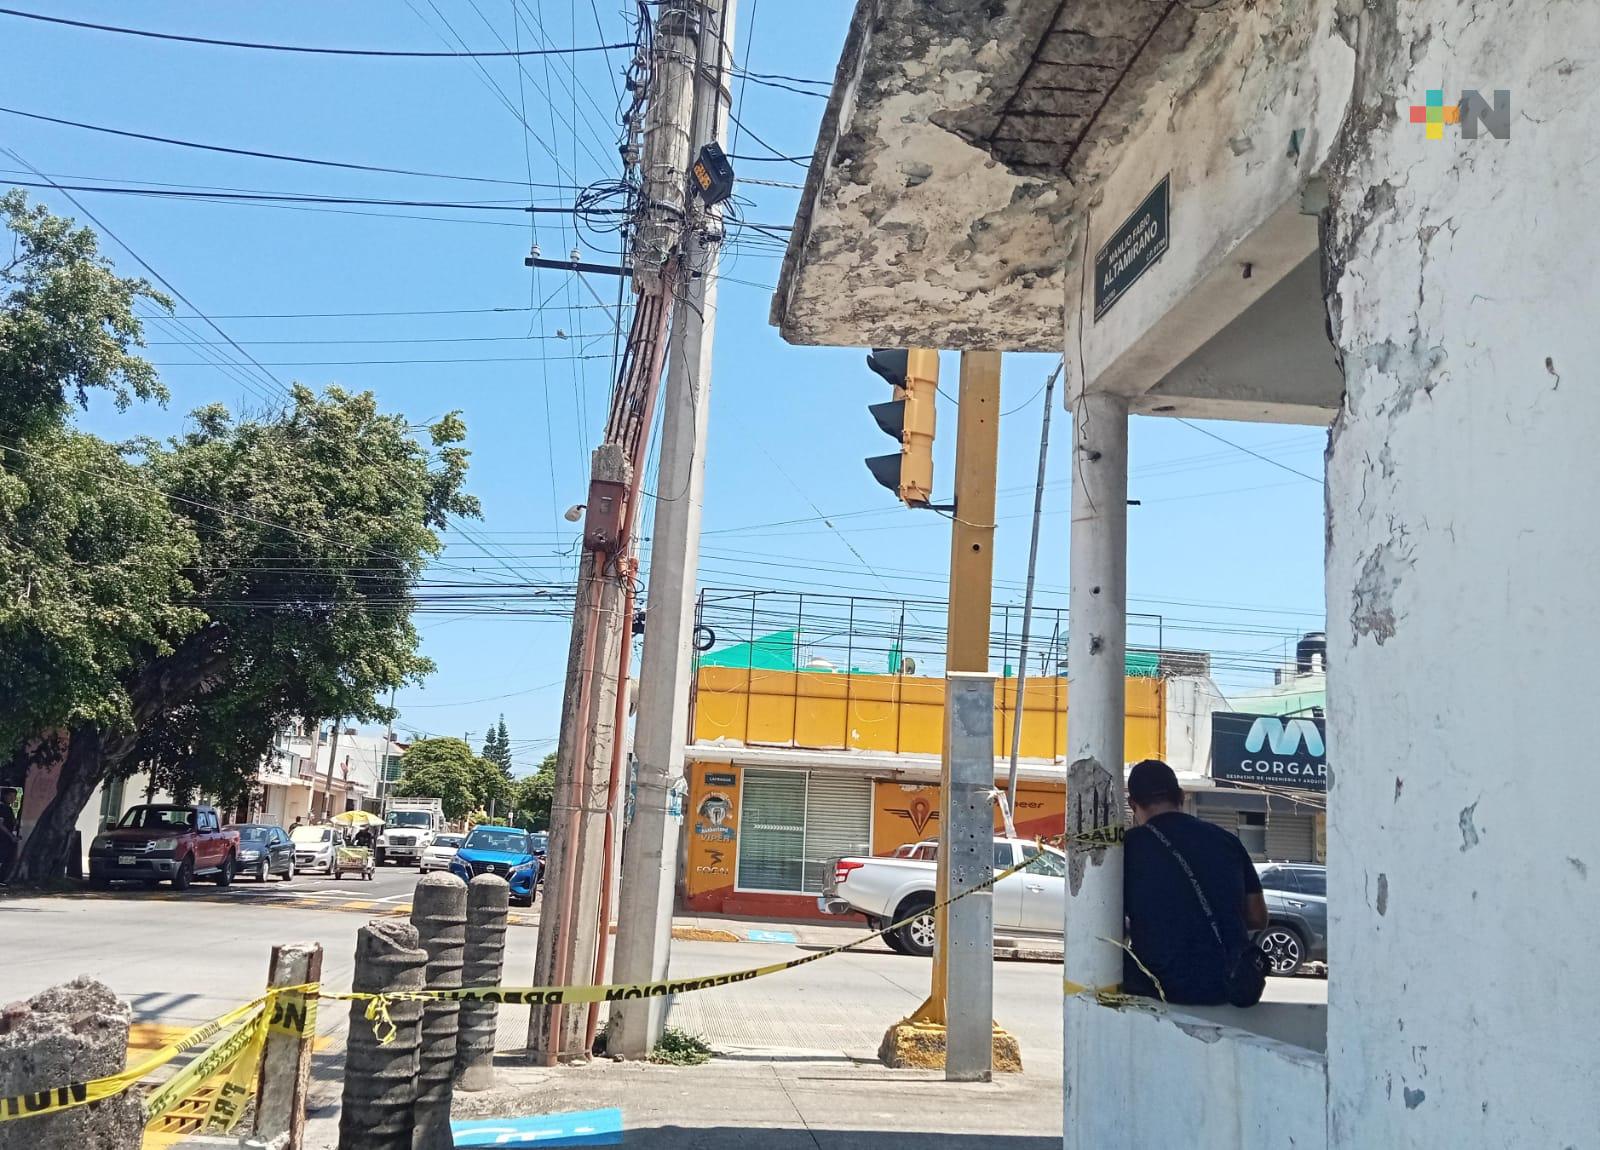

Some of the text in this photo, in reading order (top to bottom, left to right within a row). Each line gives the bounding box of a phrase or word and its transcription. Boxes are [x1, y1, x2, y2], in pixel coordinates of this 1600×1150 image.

[1103, 220, 1158, 291] ALTAMIRANO
[1109, 212, 1150, 265] MANLIO FABIO
[1240, 759, 1327, 777] CORGAR
